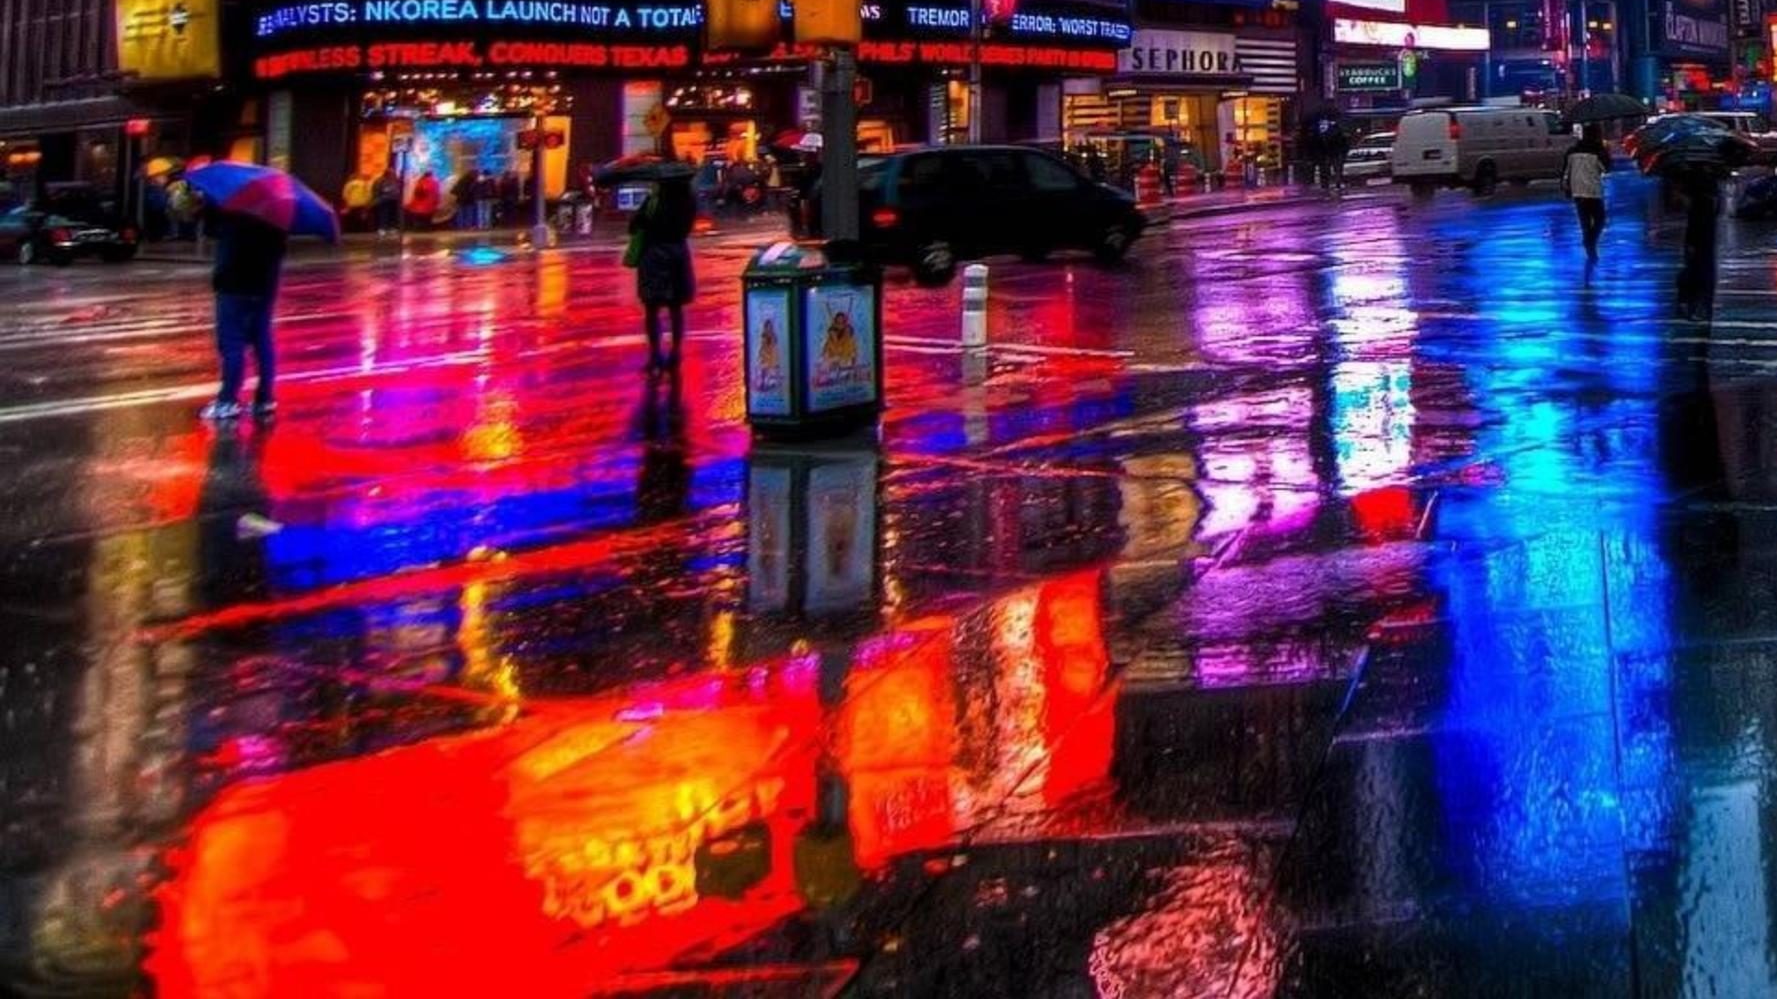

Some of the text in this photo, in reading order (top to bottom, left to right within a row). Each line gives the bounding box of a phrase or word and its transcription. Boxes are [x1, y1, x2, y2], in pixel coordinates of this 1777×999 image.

[486, 0, 576, 23] LAUNCH
[580, 6, 608, 26] NOT
[615, 5, 631, 28] A
[907, 7, 970, 28] TREMOR
[613, 46, 688, 68] TEXAS
[1131, 47, 1245, 72] SEPHORA
[1348, 76, 1386, 85] COFFEE
